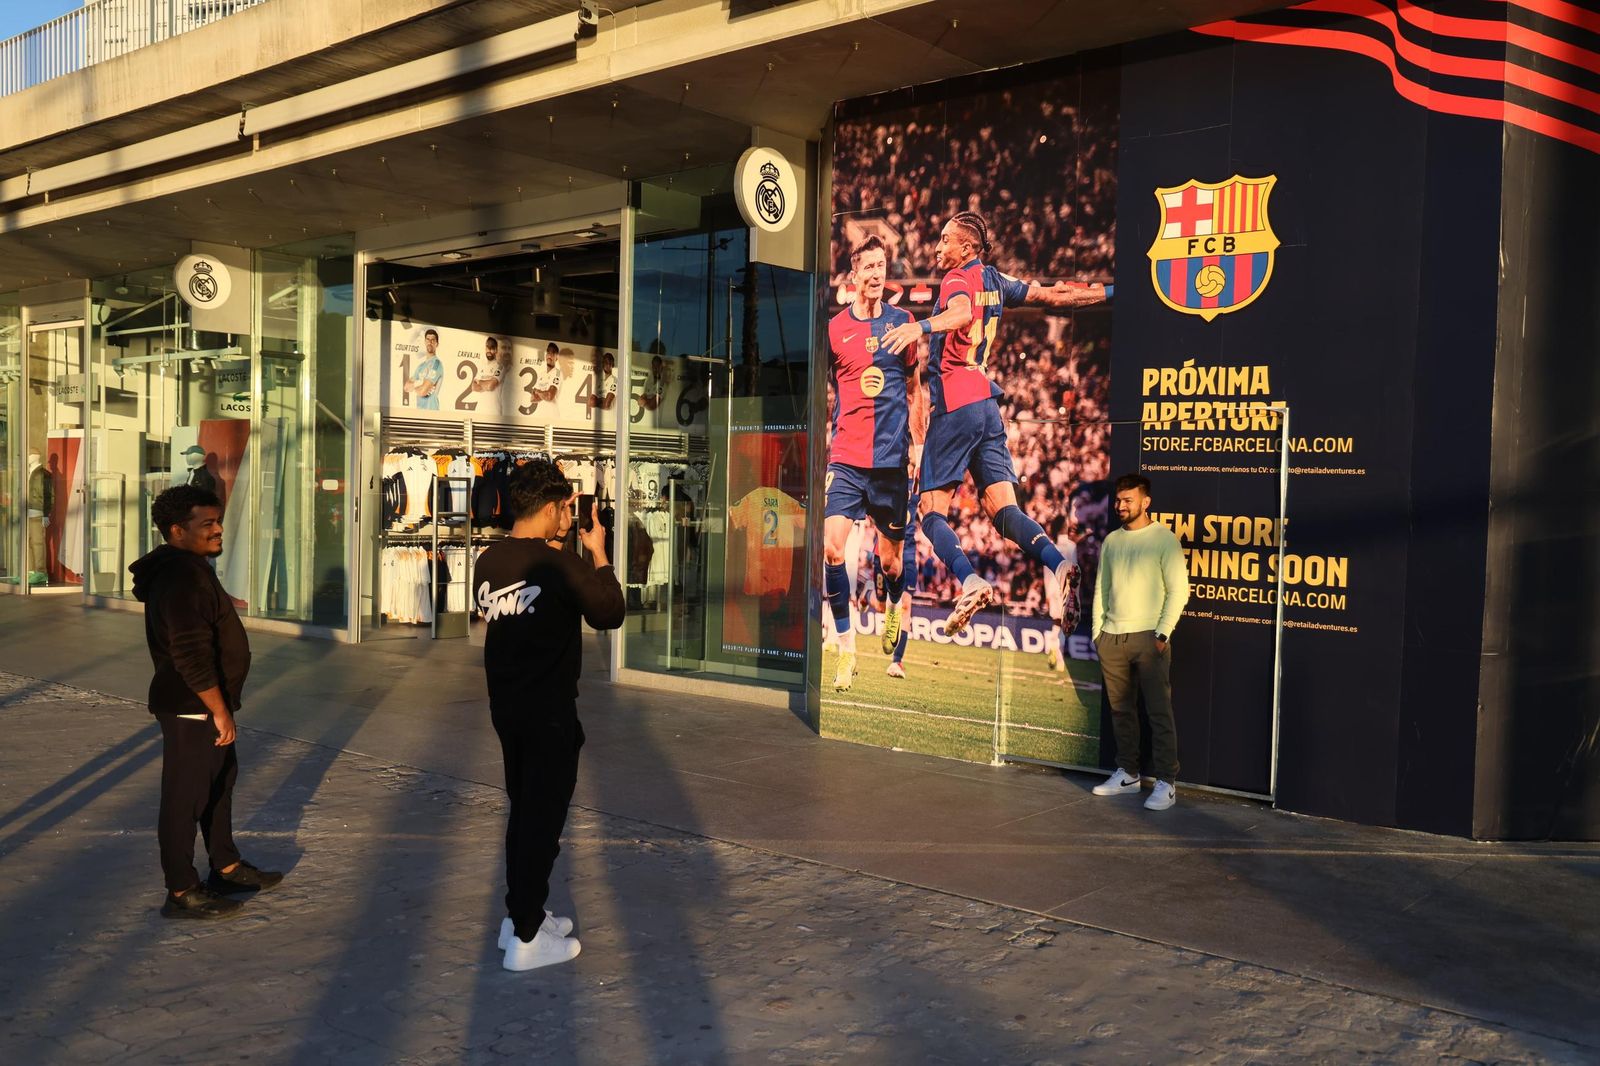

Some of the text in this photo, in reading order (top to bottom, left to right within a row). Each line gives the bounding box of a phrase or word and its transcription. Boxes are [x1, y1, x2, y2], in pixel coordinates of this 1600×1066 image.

[1188, 236, 1236, 255] FCB
[395, 343, 420, 353] COURTOIS
[455, 360, 478, 411] 2
[518, 366, 538, 415] 3
[575, 374, 593, 420] 4
[1142, 358, 1270, 397] PRÓXIMA
[1147, 464, 1169, 472] quieres
